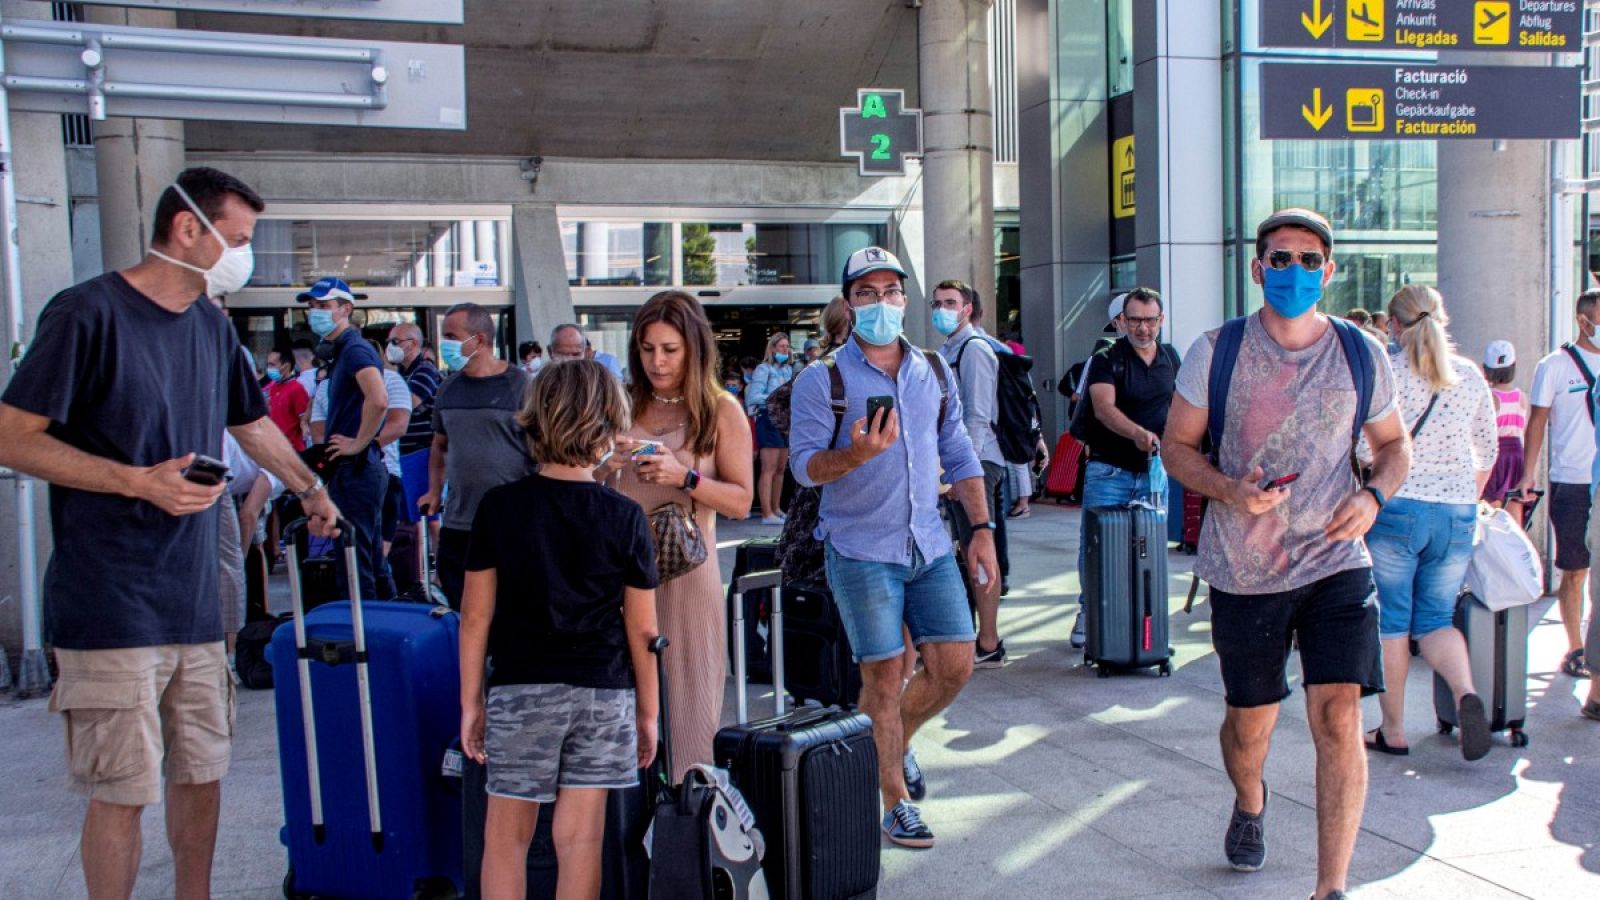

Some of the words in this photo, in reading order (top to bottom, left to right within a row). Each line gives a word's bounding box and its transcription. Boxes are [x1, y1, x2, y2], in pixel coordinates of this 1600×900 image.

[1520, 0, 1576, 13] Departures
[1396, 12, 1437, 27] Ankunft
[1519, 15, 1552, 31] Abflug
[1395, 28, 1458, 48] Llegadas
[1519, 31, 1566, 46] Salidas
[1395, 68, 1468, 84] Facturació
[1395, 86, 1440, 100] Check-in
[862, 93, 886, 118] A
[1395, 102, 1476, 119] Gepäckaufgabe
[1395, 119, 1476, 134] Facturación
[870, 133, 891, 160] 2
